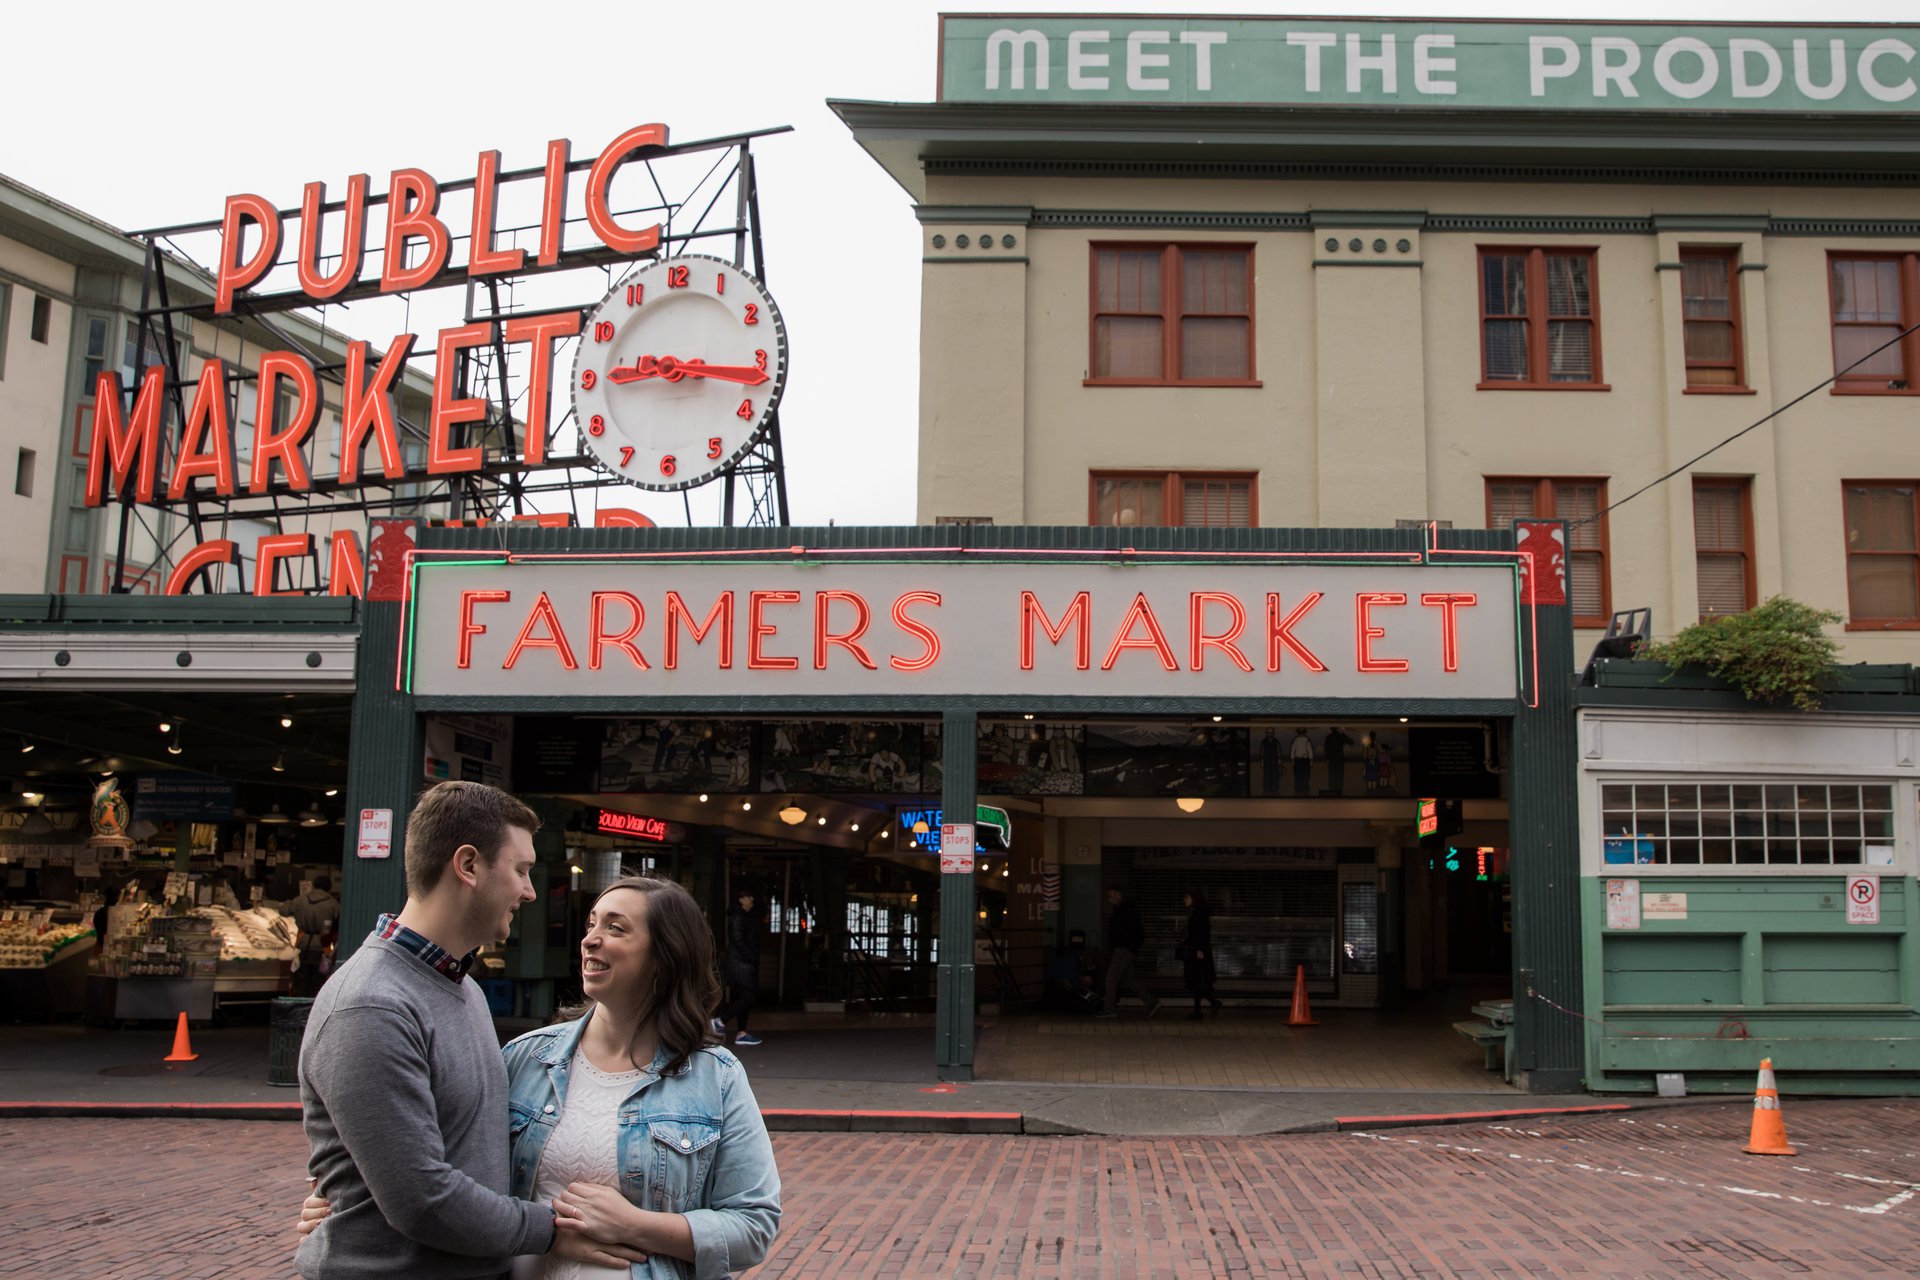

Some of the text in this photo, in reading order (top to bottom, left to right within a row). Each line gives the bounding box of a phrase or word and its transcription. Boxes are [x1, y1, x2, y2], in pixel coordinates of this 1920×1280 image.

[985, 28, 1918, 102] MEET THE PRODUC
[214, 122, 671, 314] PUBLIC
[667, 265, 690, 288] 12
[717, 273, 725, 295] 1
[626, 283, 645, 307] 11
[743, 303, 758, 326] 2
[594, 321, 615, 343] 10
[755, 349, 768, 371] 3
[581, 369, 597, 391] 9
[84, 310, 588, 507] MARKET
[736, 399, 755, 421] 4
[589, 415, 605, 437] 8
[619, 446, 635, 468] 7
[707, 437, 723, 459] 5
[660, 455, 677, 477] 6
[457, 590, 1478, 672] FARMERS MARKET
[365, 821, 387, 829] STOPS
[946, 836, 970, 845] STOPS
[1851, 911, 1875, 919] SPACE
